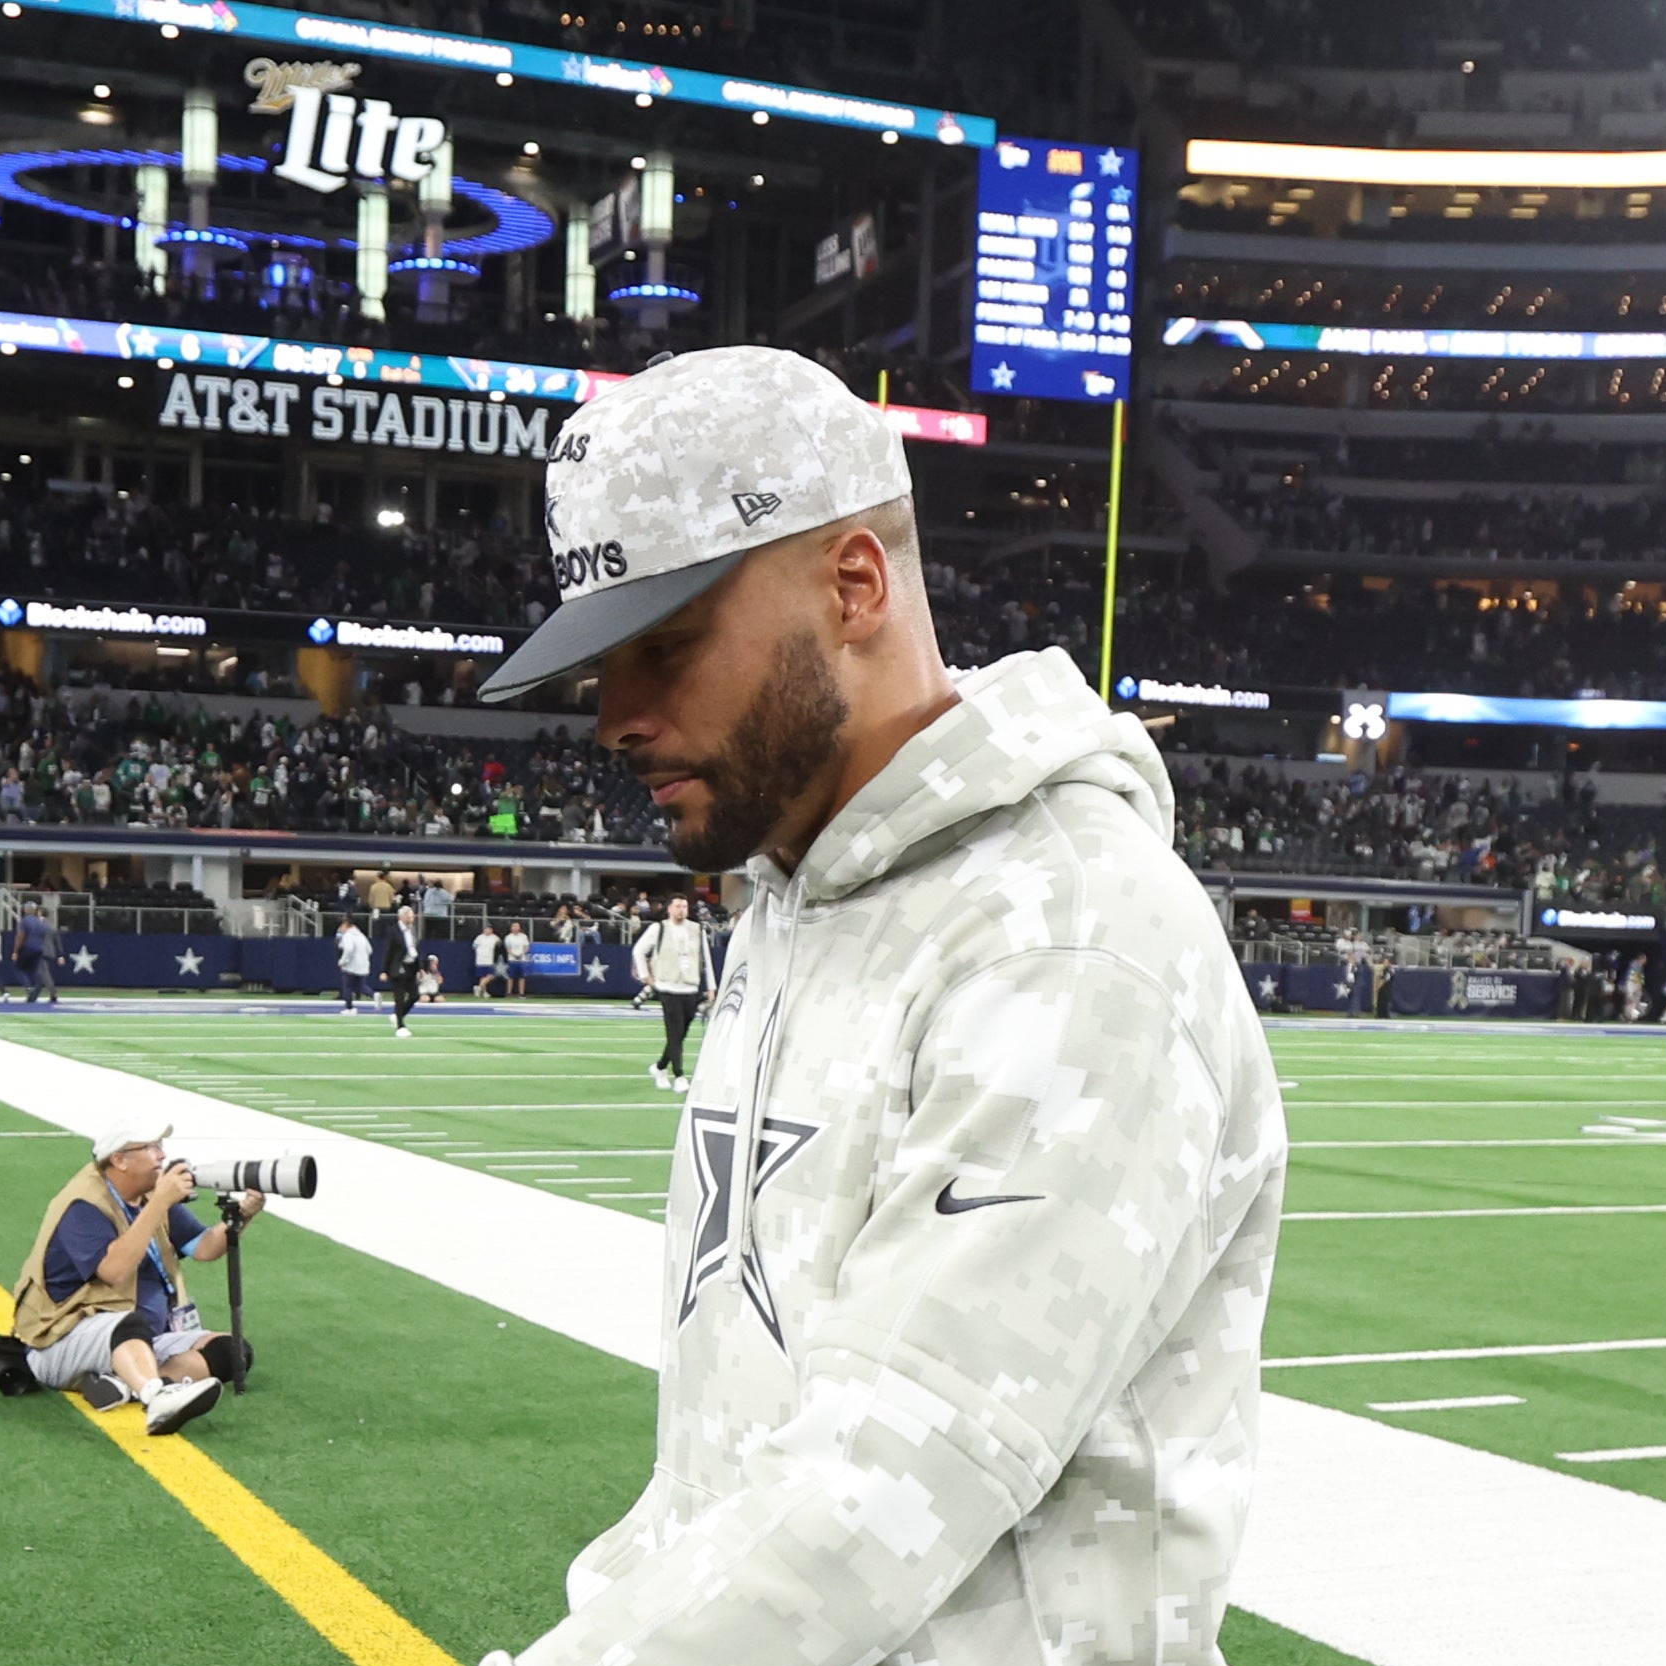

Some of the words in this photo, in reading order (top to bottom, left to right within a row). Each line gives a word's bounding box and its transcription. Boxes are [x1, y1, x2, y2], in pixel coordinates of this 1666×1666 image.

[272, 84, 446, 193] Lite
[158, 372, 301, 438] AT&T
[311, 384, 548, 460] STADIUM
[25, 601, 207, 636] Blockchain.com
[336, 620, 504, 654] Blockchain.com
[1138, 677, 1271, 710] Blockchain.com
[1466, 984, 1517, 1000] SERVICE
